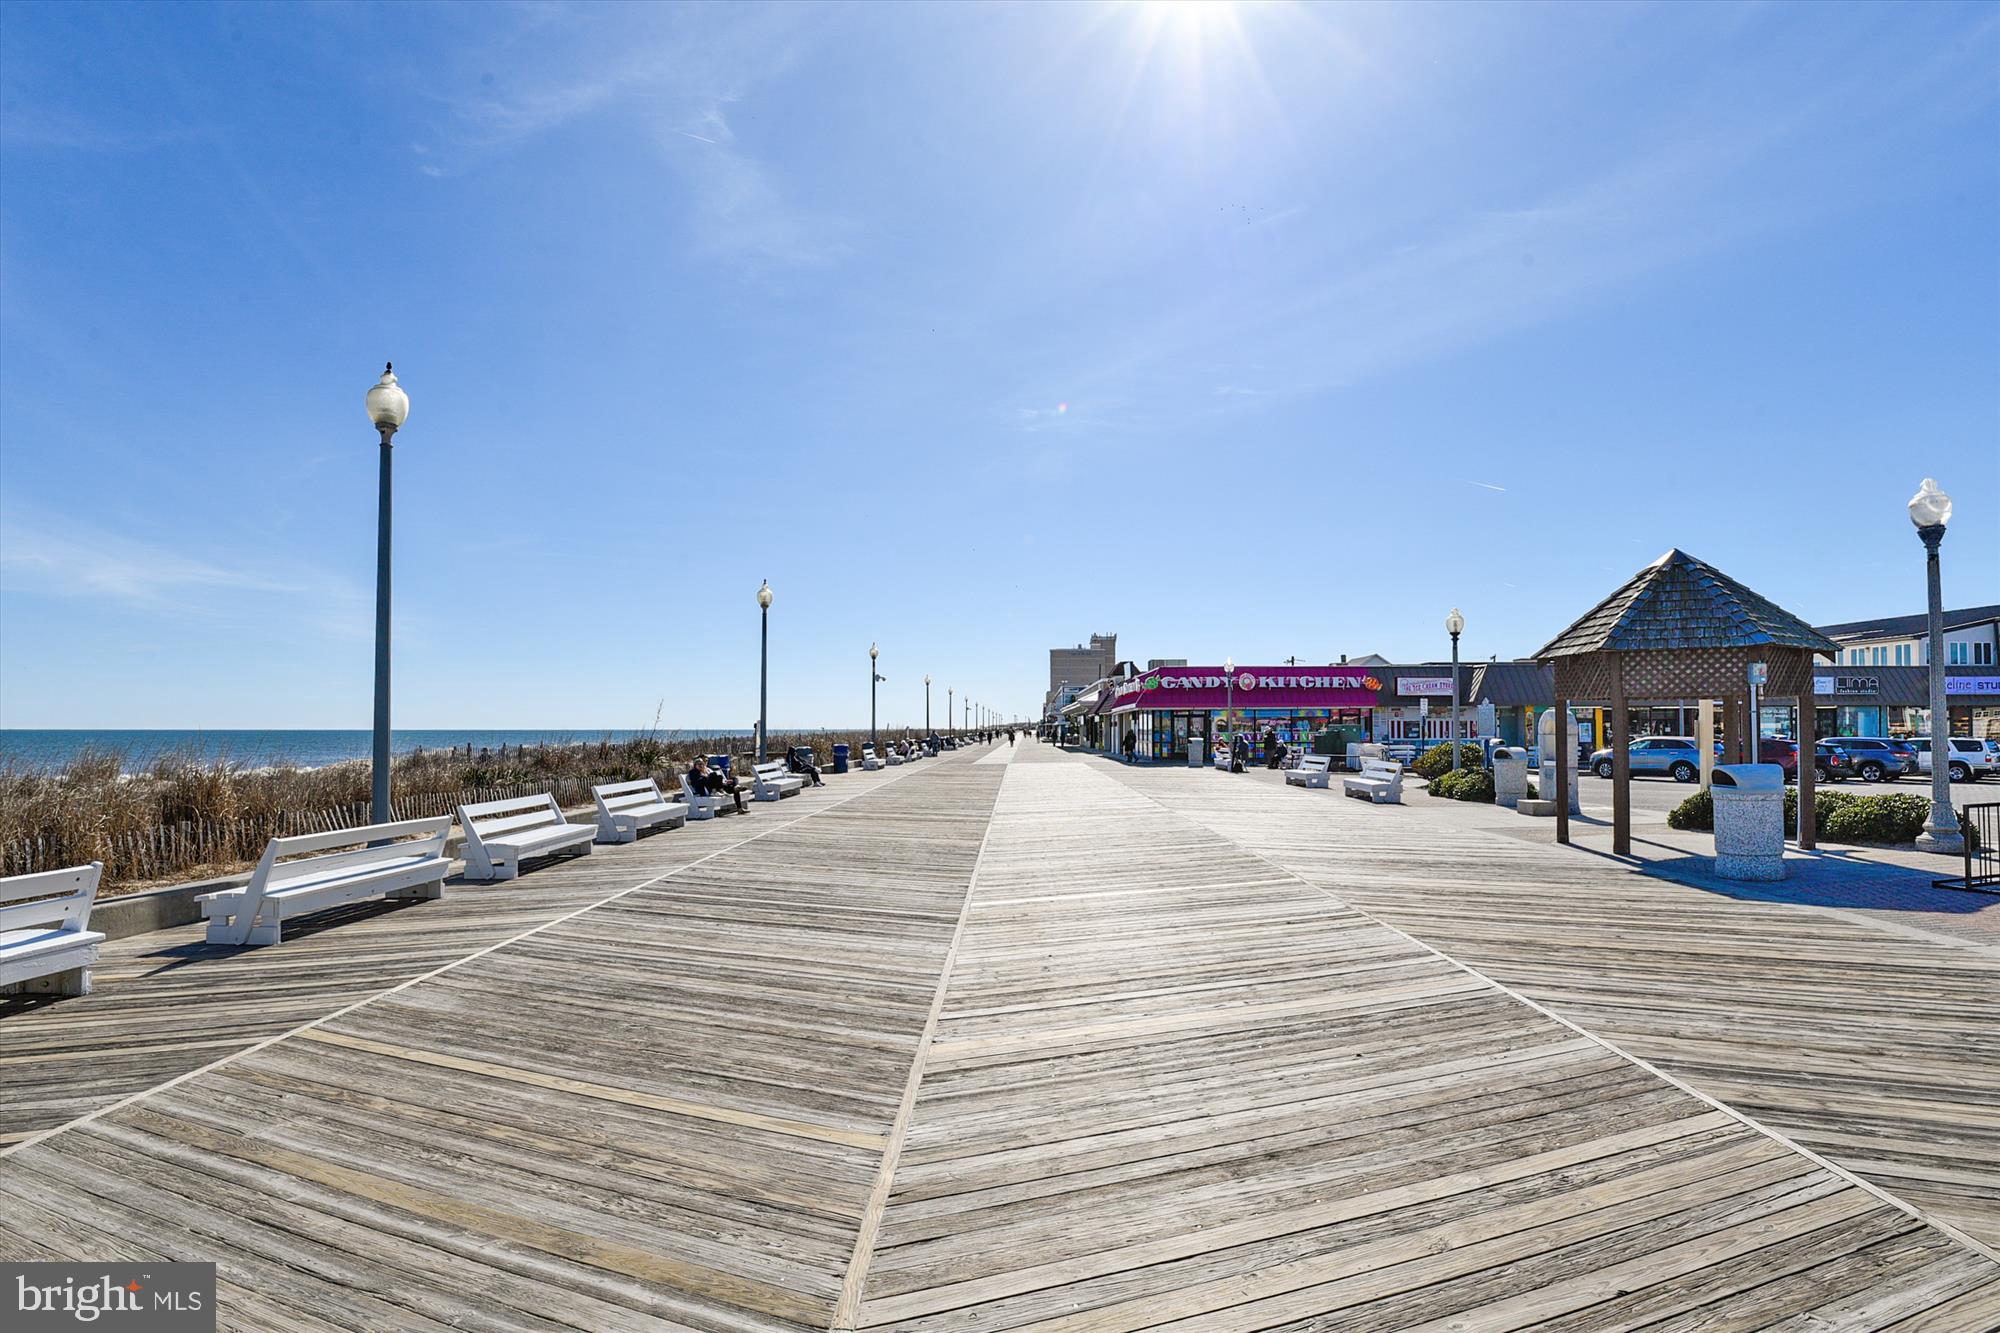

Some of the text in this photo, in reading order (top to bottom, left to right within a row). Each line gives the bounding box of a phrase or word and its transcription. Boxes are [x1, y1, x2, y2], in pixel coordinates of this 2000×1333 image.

[1160, 675, 1362, 689] CANDY KITCHEN
[1977, 681, 2000, 690] STU
